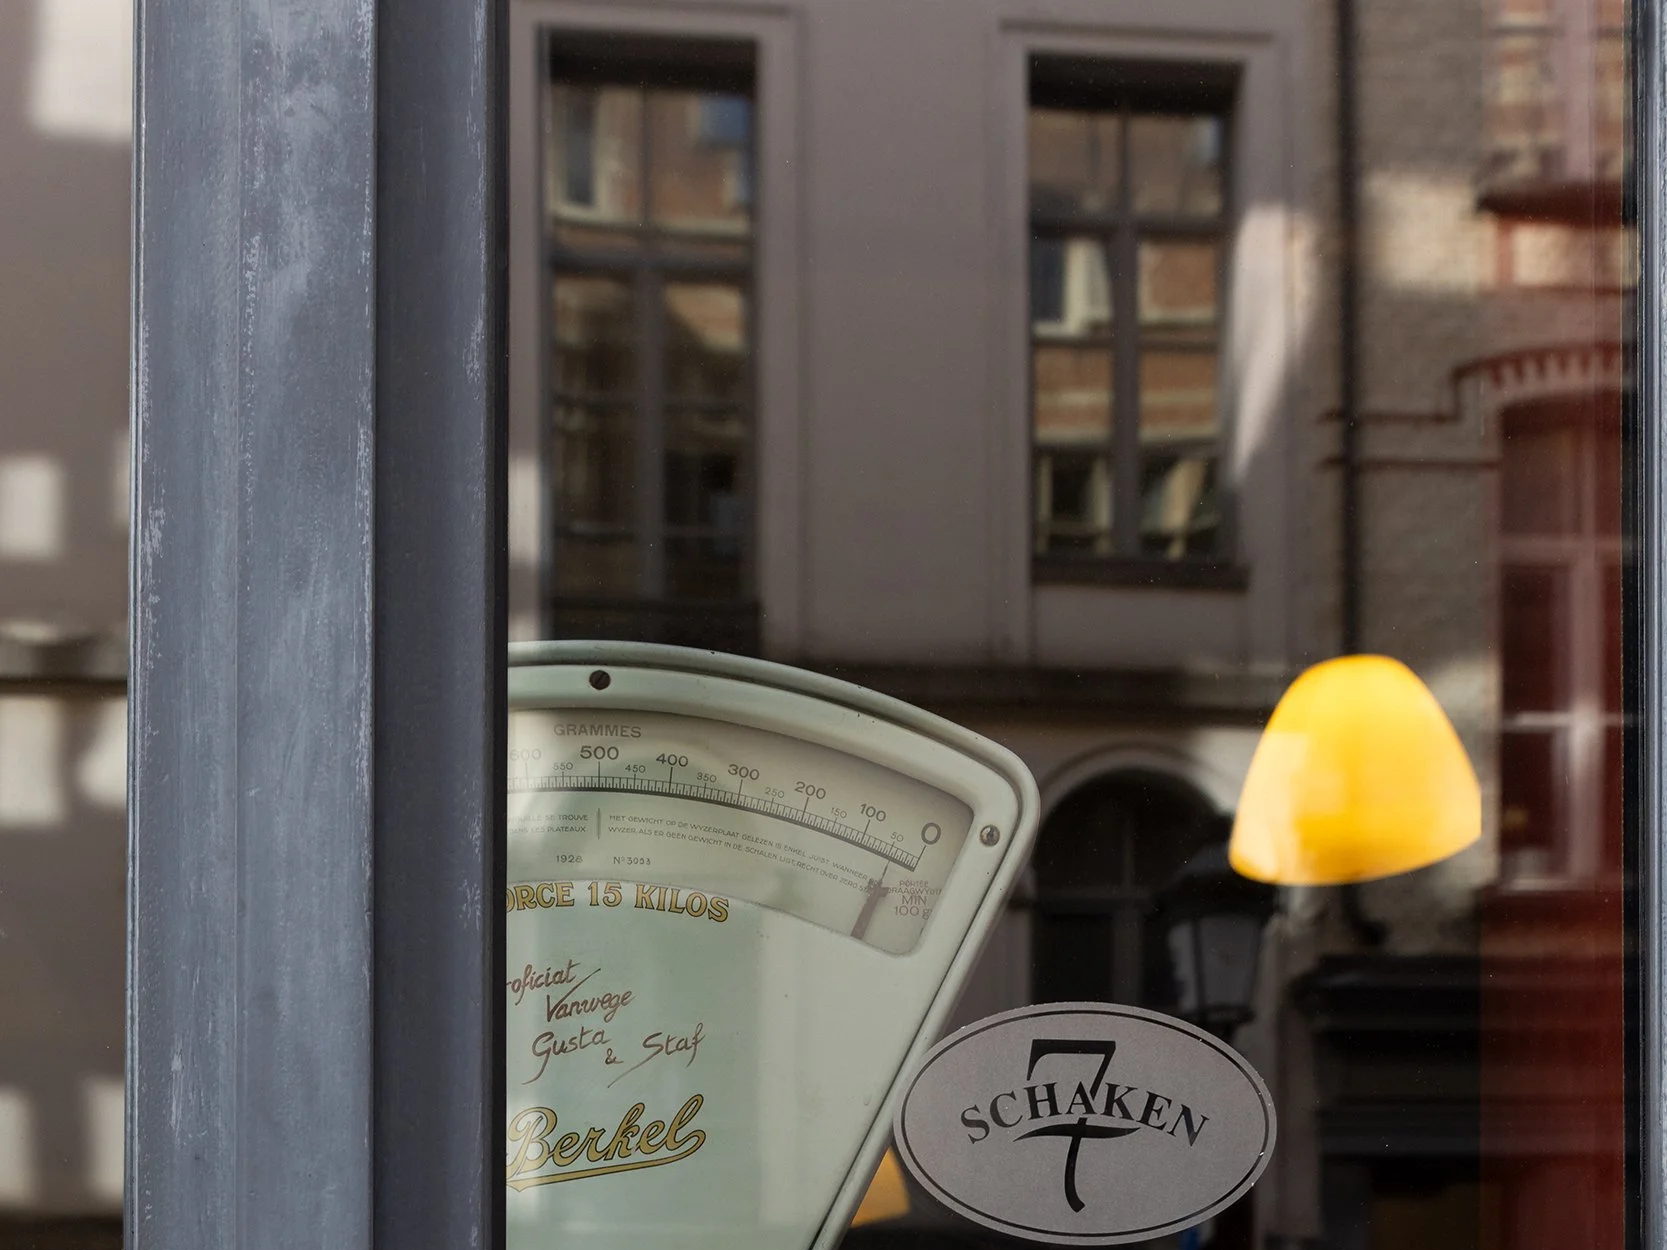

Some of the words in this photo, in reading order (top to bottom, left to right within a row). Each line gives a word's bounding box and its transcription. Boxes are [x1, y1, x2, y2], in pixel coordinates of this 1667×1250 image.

[553, 724, 641, 738] GRAMMES
[510, 749, 541, 761] 600
[580, 746, 619, 760] 500
[656, 753, 688, 767] 400
[553, 762, 573, 770] 550
[625, 764, 646, 773] 450
[727, 764, 760, 780] 300
[696, 772, 717, 783] 350
[765, 787, 785, 799] 250
[794, 781, 826, 800] 200
[830, 807, 847, 819] 150
[860, 803, 886, 822] 100
[890, 831, 904, 843] 50
[921, 822, 942, 845] 0
[628, 816, 663, 824] GEWICHT
[741, 834, 773, 847] GELEZEN
[832, 862, 868, 880] WANNEER
[733, 843, 743, 851] DE
[507, 882, 575, 912] RCE
[588, 882, 622, 907] 15
[634, 883, 729, 923] KILOS
[902, 895, 927, 905] MIN
[895, 905, 919, 916] 100
[507, 960, 580, 1006] oficiat
[547, 968, 635, 1023] Vanwege
[522, 1026, 611, 1085] Gusta
[605, 1048, 624, 1064] &
[608, 1022, 706, 1088] Staf
[960, 1080, 1209, 1148] SCHAKEN
[507, 1094, 706, 1184] Berkel
